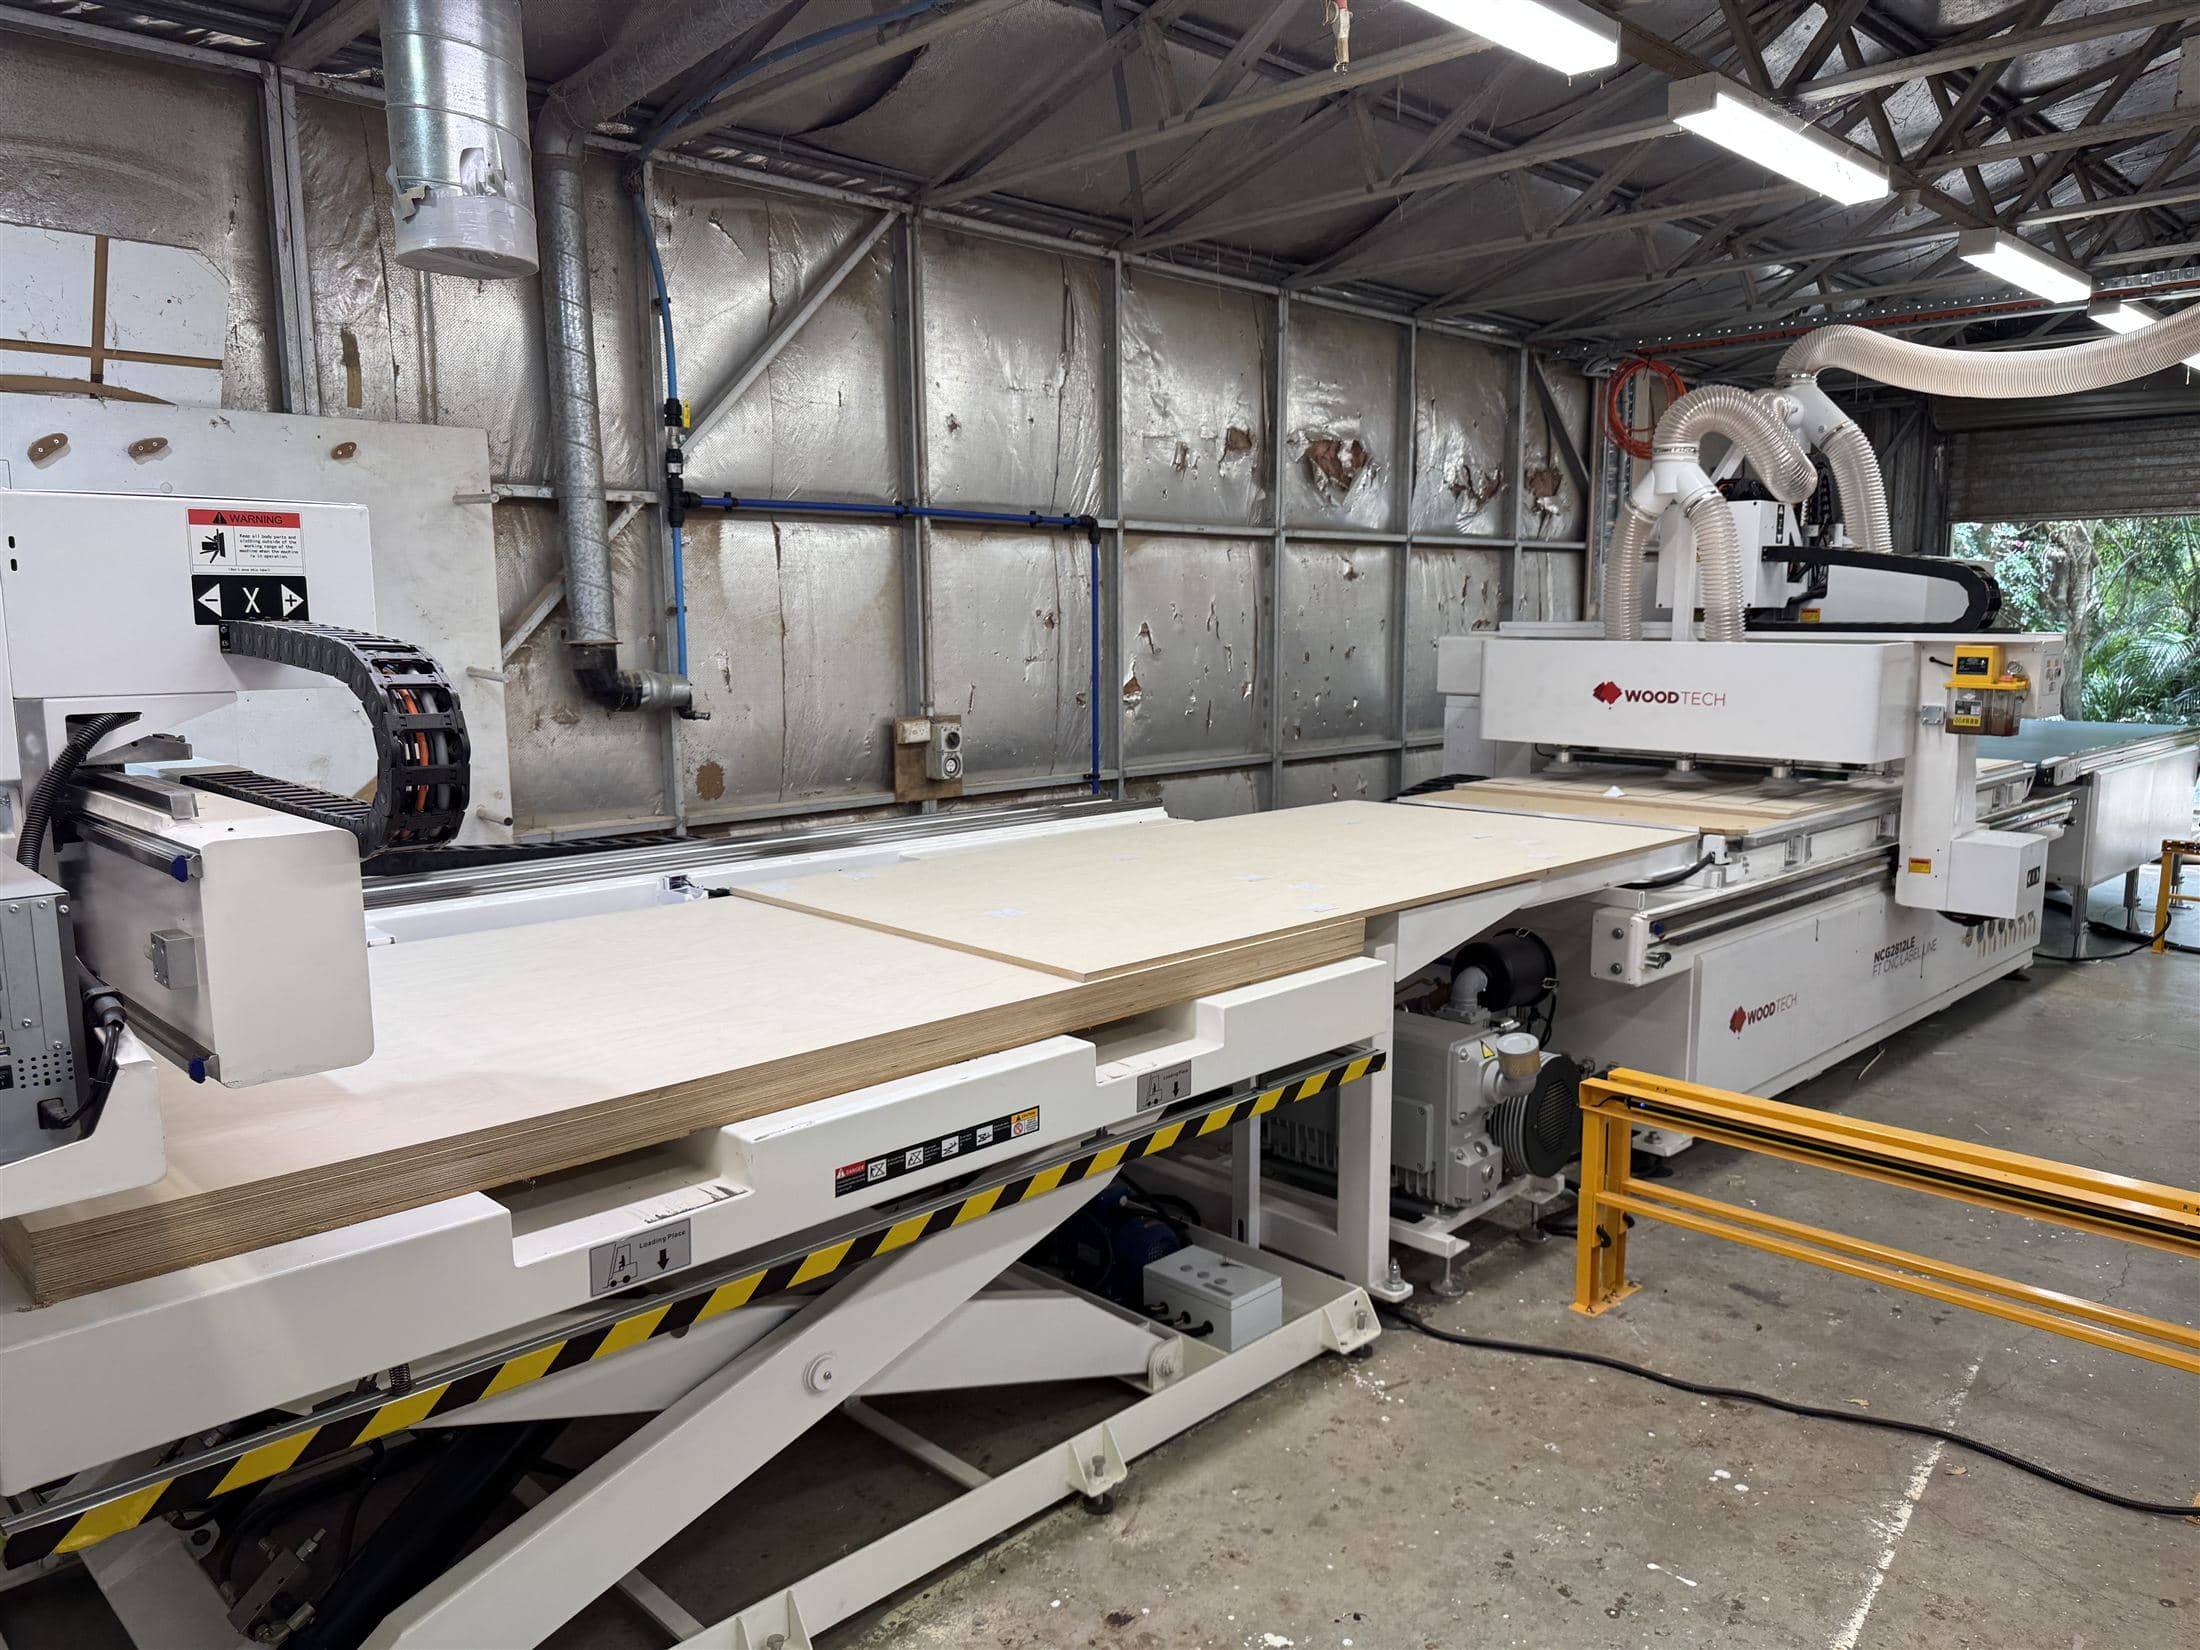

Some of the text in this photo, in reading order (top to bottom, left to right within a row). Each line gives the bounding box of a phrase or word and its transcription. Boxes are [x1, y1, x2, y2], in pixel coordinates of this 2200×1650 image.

[229, 514, 283, 525] WARNING
[242, 587, 261, 613] X
[639, 1230, 686, 1249] Loading Place
